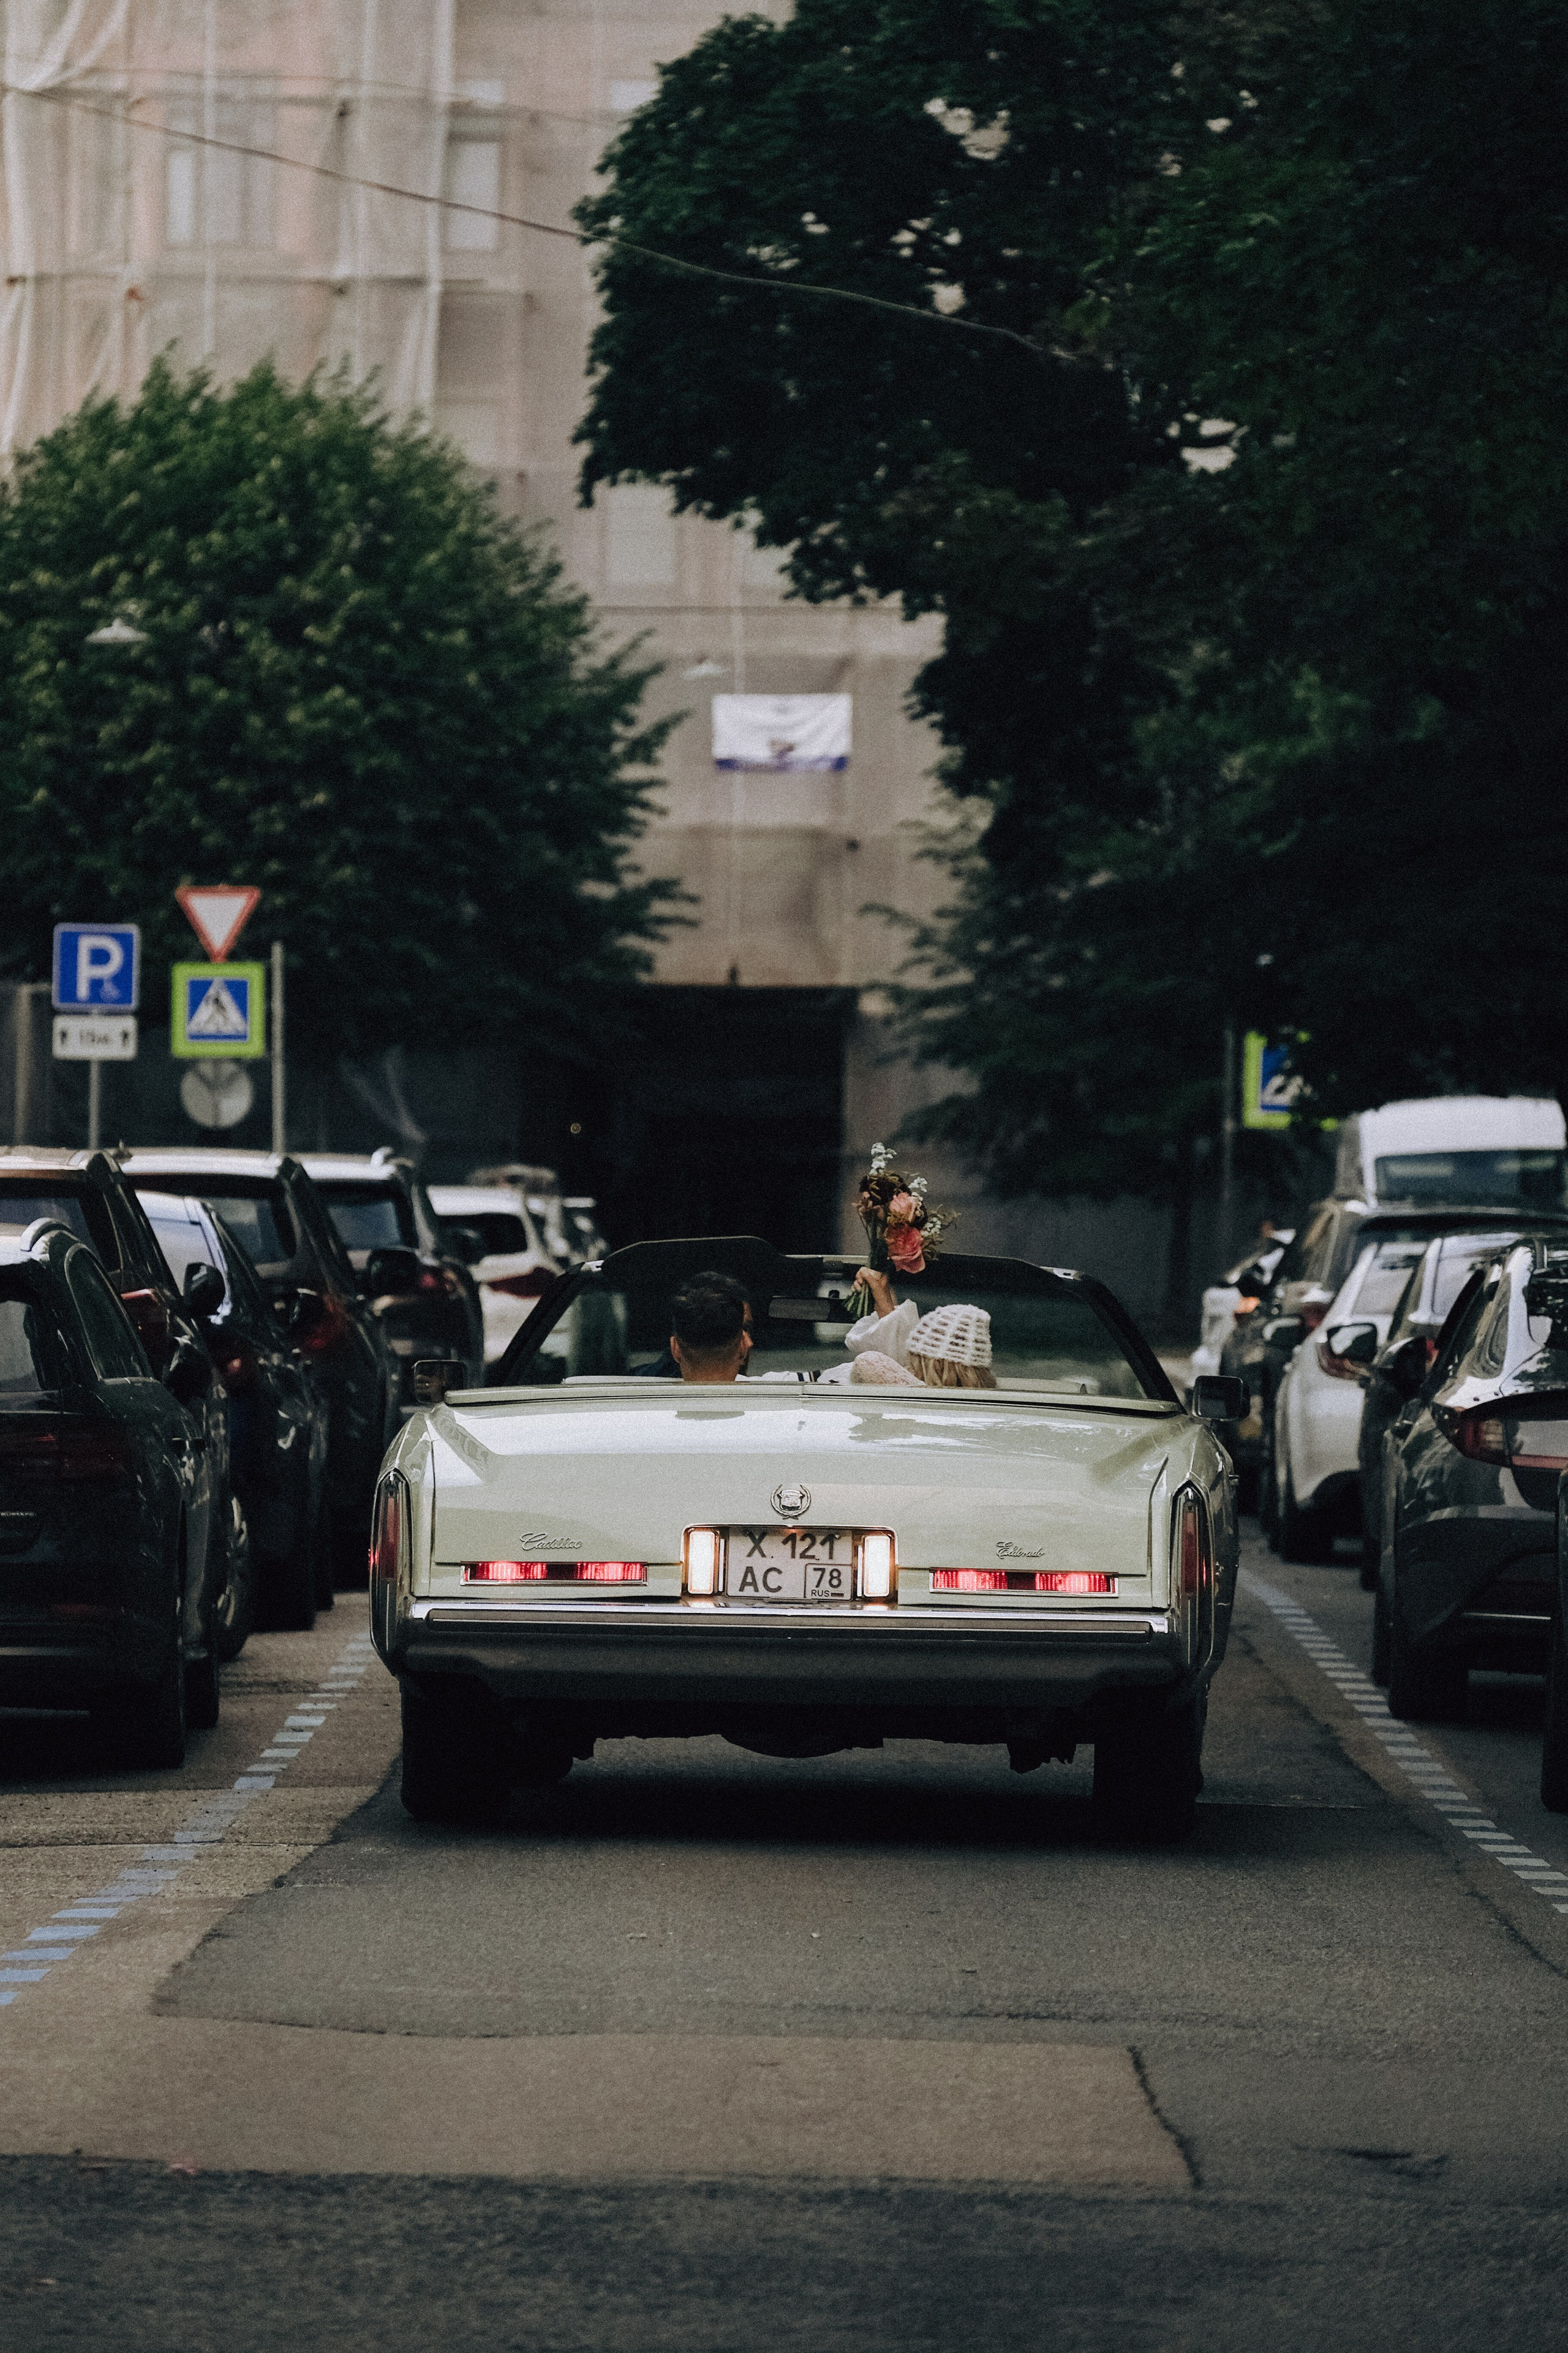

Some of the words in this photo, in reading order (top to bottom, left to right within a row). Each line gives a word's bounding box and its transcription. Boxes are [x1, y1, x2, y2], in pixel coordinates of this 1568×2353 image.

[77, 935, 124, 1001] P
[519, 1533, 583, 1551] Cadillac
[782, 1532, 835, 1560] 121
[996, 1541, 1046, 1560] Eldorado
[739, 1566, 782, 1593] AC
[813, 1568, 842, 1589] 78
